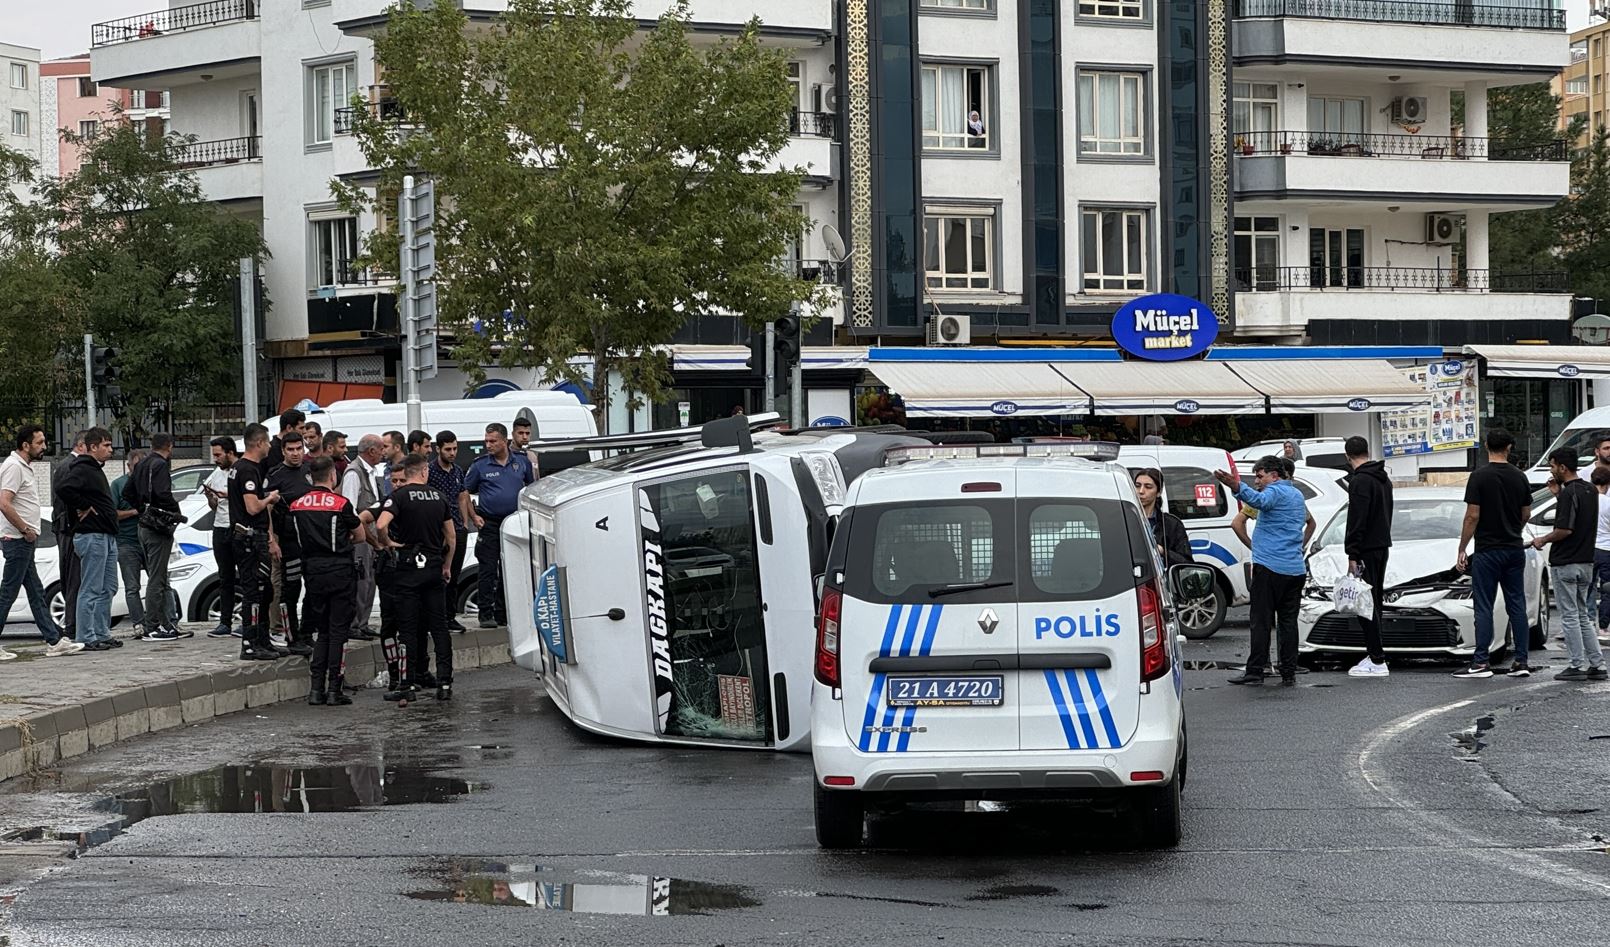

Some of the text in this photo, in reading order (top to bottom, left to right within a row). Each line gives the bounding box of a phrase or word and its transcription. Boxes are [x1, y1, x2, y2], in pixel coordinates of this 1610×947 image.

[1134, 308, 1199, 335] Müçel
[1144, 332, 1192, 349] market
[992, 403, 1016, 412] MÜÇEL
[1176, 401, 1198, 411] MÜÇEL
[409, 490, 440, 501] POLİS
[1197, 487, 1213, 497] 112
[296, 493, 335, 507] POLİS
[595, 516, 609, 531] A
[1340, 586, 1358, 600] getir
[1034, 608, 1121, 639] POLİS
[897, 681, 993, 697] 21 A 4720
